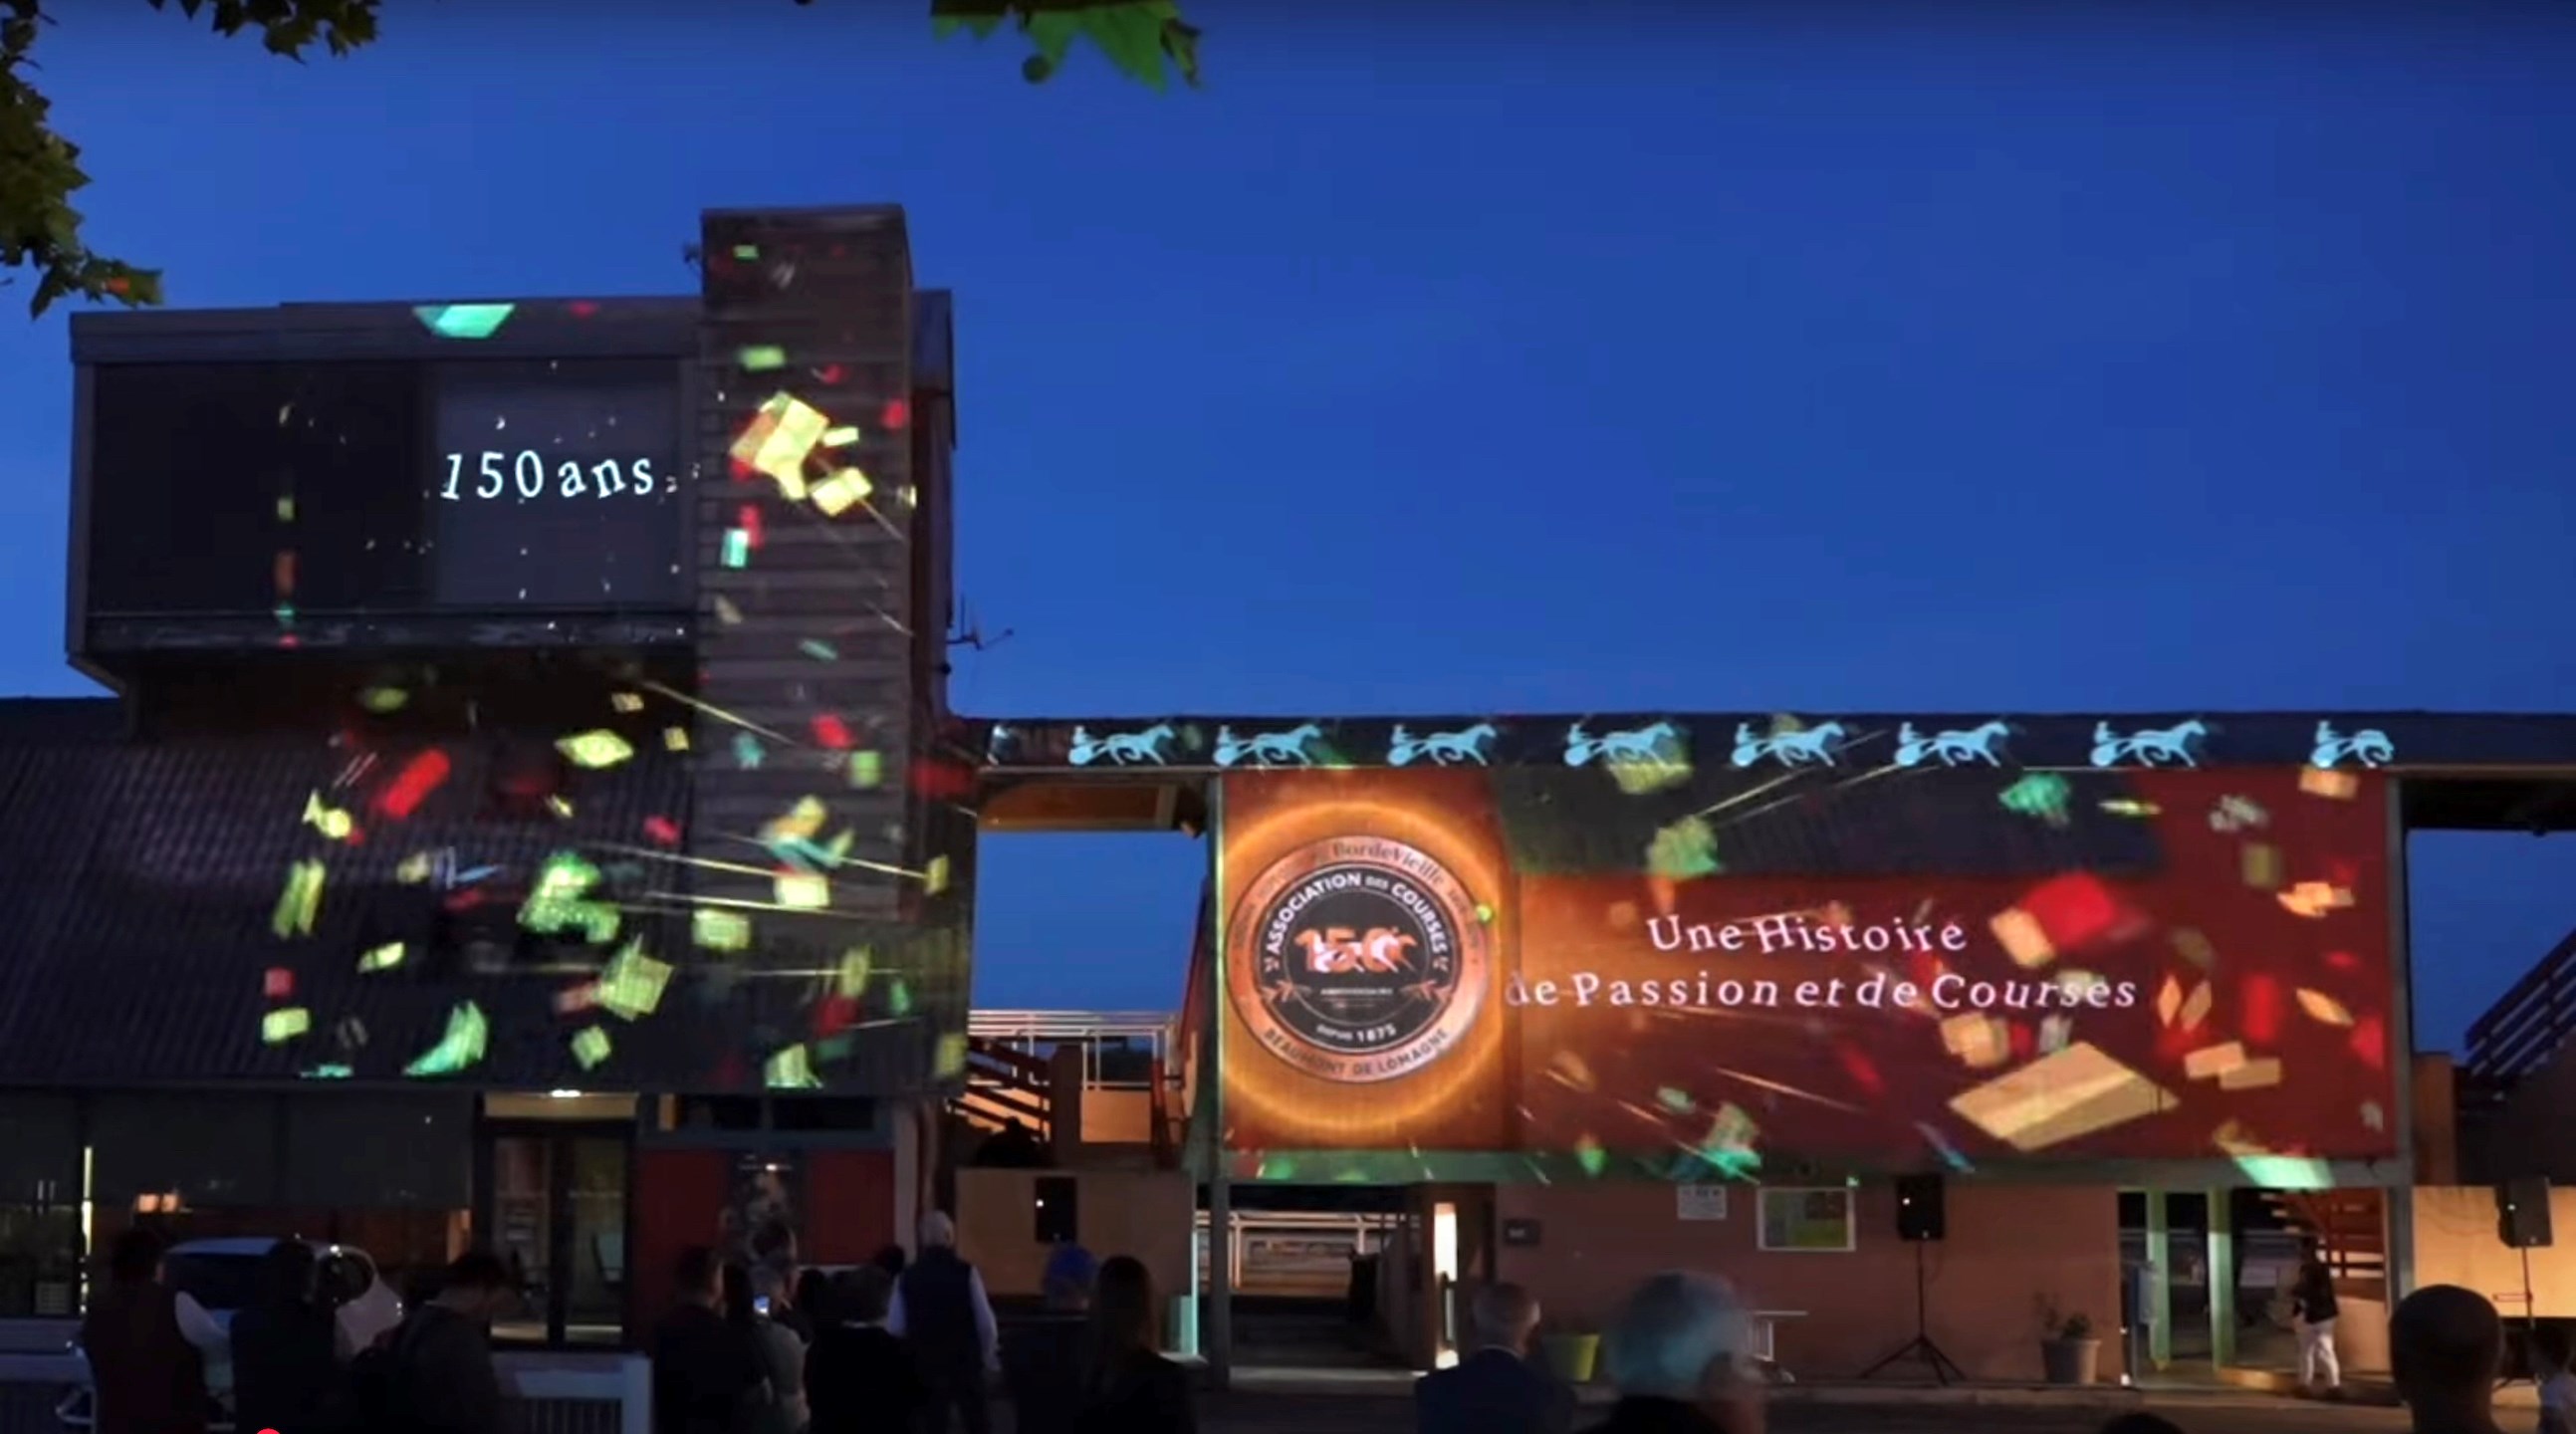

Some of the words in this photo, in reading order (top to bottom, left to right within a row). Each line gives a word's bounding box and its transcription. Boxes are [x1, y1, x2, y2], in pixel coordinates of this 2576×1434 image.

[439, 449, 544, 500] 150
[558, 457, 654, 499] ans
[1265, 872, 1361, 956] ASSOCIATION
[1390, 881, 1449, 953] COURSES
[1646, 913, 1744, 952] Une
[1752, 913, 1968, 954] Histoire
[1505, 969, 1560, 1008] de
[1570, 970, 1778, 1008] Passion
[1793, 978, 1846, 1009] et
[1855, 972, 1919, 1009] de
[1931, 973, 2137, 1010] Courses
[1263, 1027, 1345, 1074] BEAUMONT
[1352, 1062, 1373, 1076] DE
[1378, 1027, 1449, 1074] LOMAGNE
[1355, 1023, 1397, 1043] 1875
